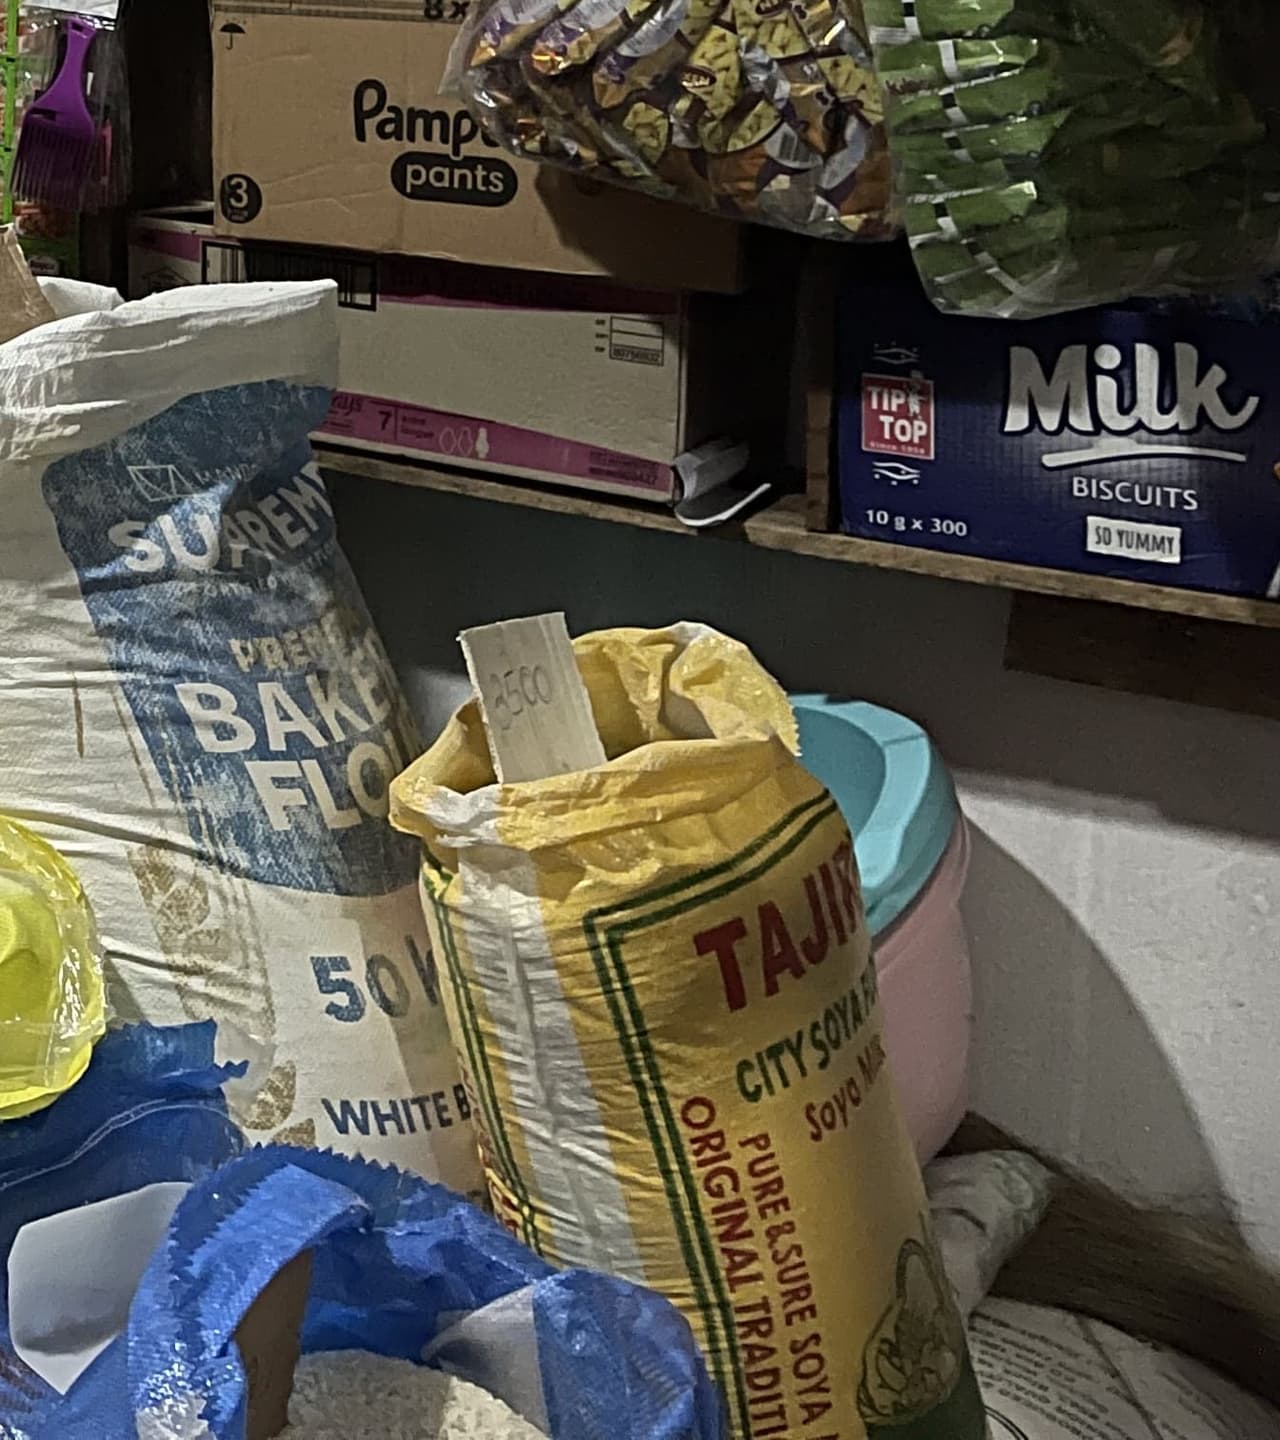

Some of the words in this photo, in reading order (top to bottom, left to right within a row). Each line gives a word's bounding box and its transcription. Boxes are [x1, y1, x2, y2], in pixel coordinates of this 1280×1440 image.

[229, 178, 249, 210] 3
[405, 162, 505, 194] pants
[868, 385, 905, 410] TIP
[1003, 342, 1259, 434] Milk
[378, 410, 391, 431] 7
[880, 413, 929, 444] TOP
[1072, 476, 1199, 510] BISCUITS
[865, 509, 889, 526] 10
[893, 515, 906, 531] g
[912, 519, 924, 530] x
[930, 517, 968, 537] 300
[1095, 525, 1113, 546] SO
[1117, 529, 1175, 556] YUMMY
[490, 666, 552, 733] 3500
[310, 954, 414, 1025] 50
[736, 1034, 810, 1104] CITY
[809, 993, 866, 1071] SOYA
[324, 1090, 452, 1138] WHITE
[681, 1095, 760, 1295] ORIGINAL
[789, 1331, 833, 1425] SOYA
